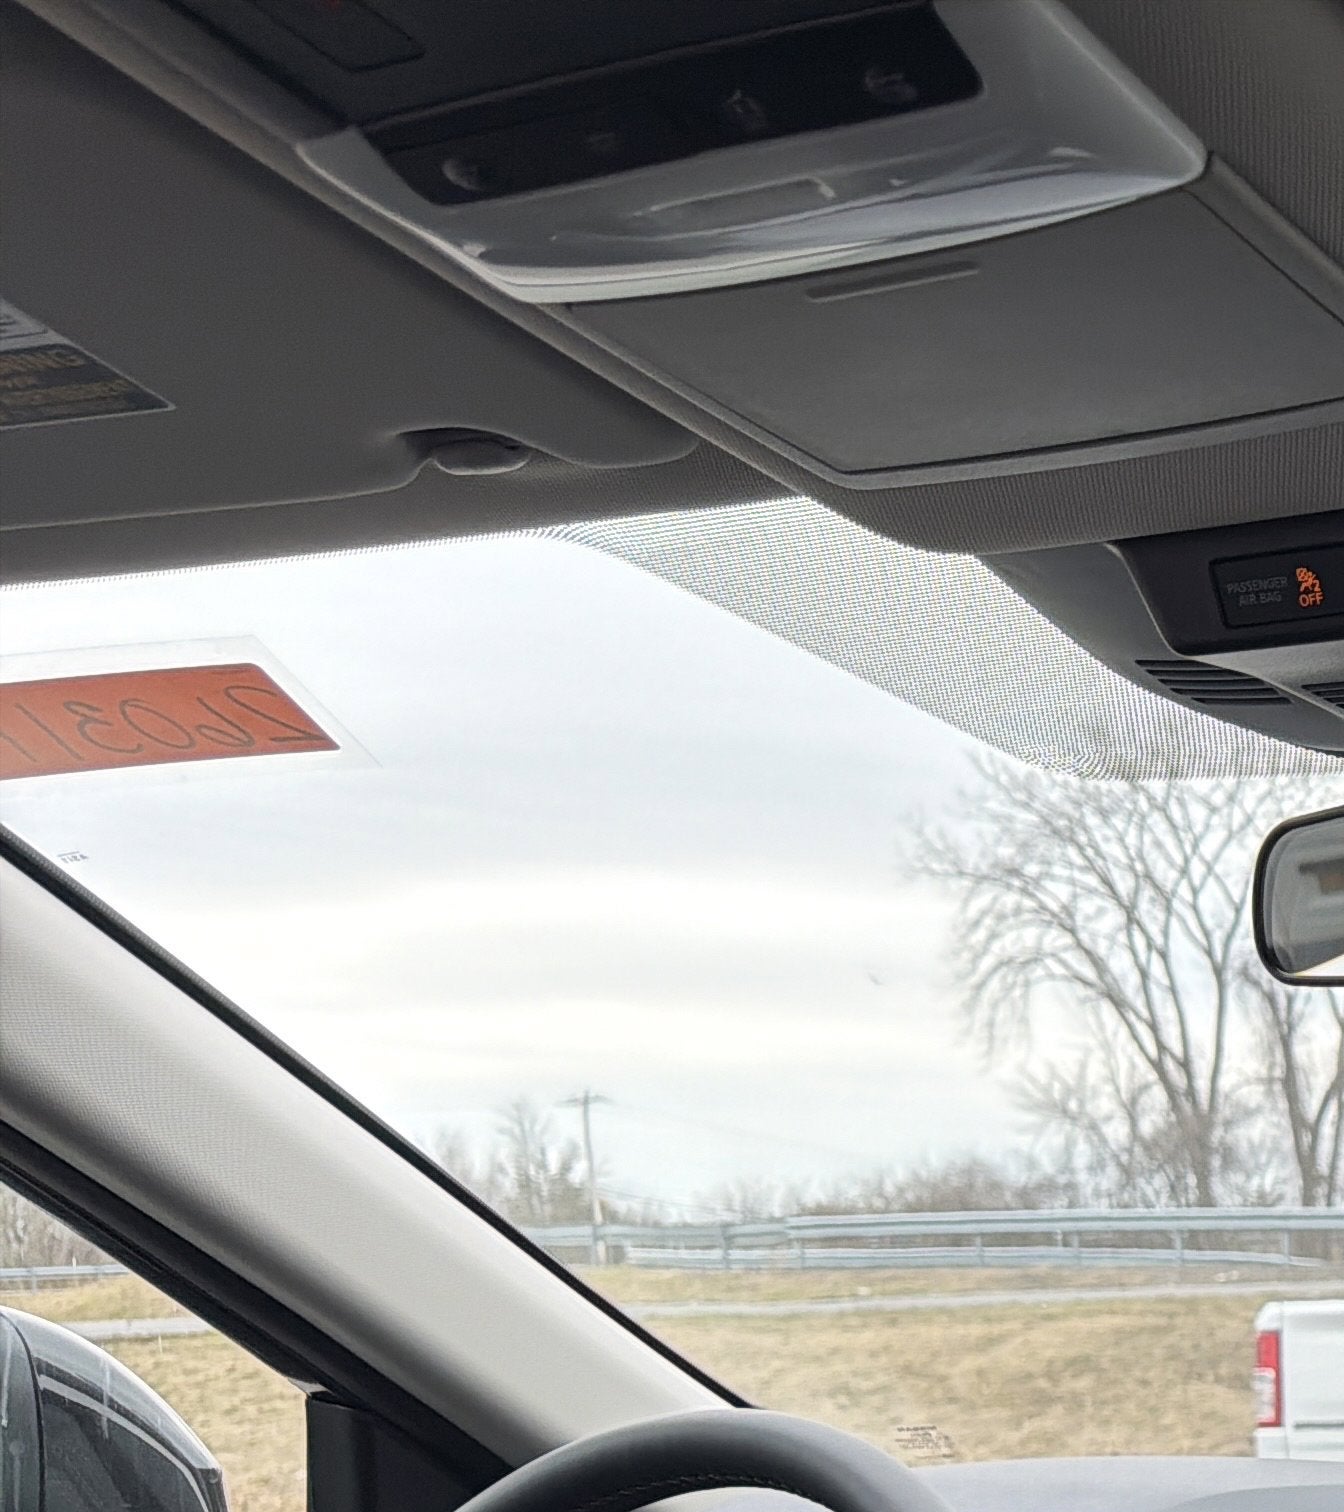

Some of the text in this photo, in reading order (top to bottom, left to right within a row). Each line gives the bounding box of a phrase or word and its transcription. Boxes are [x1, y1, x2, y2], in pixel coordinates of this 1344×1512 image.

[1226, 576, 1289, 594] PASSENGER
[1239, 591, 1282, 607] AIR BAG
[1299, 592, 1323, 607] OFF
